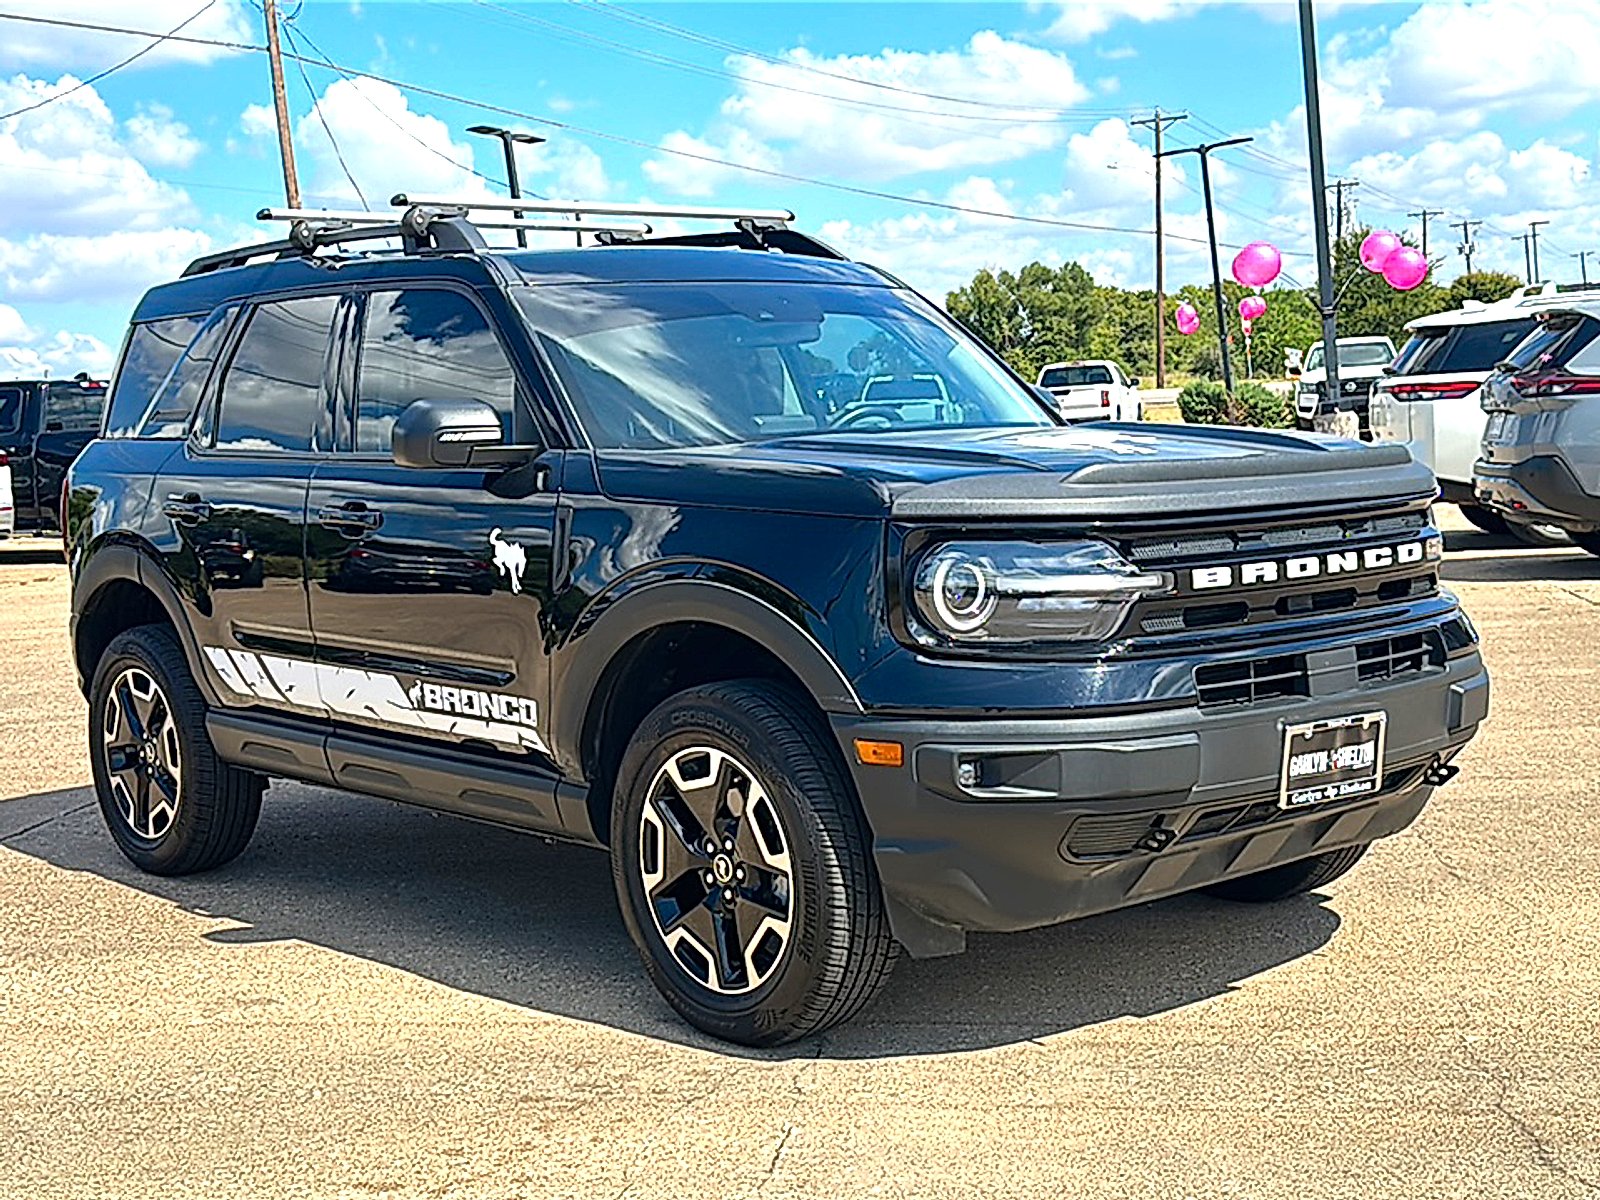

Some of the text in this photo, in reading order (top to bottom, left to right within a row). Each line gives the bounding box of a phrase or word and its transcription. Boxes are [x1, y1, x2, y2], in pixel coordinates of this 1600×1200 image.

[1192, 543, 1423, 590] BRONCO
[423, 683, 538, 727] BRONCO
[671, 710, 750, 748] CROSSOVER
